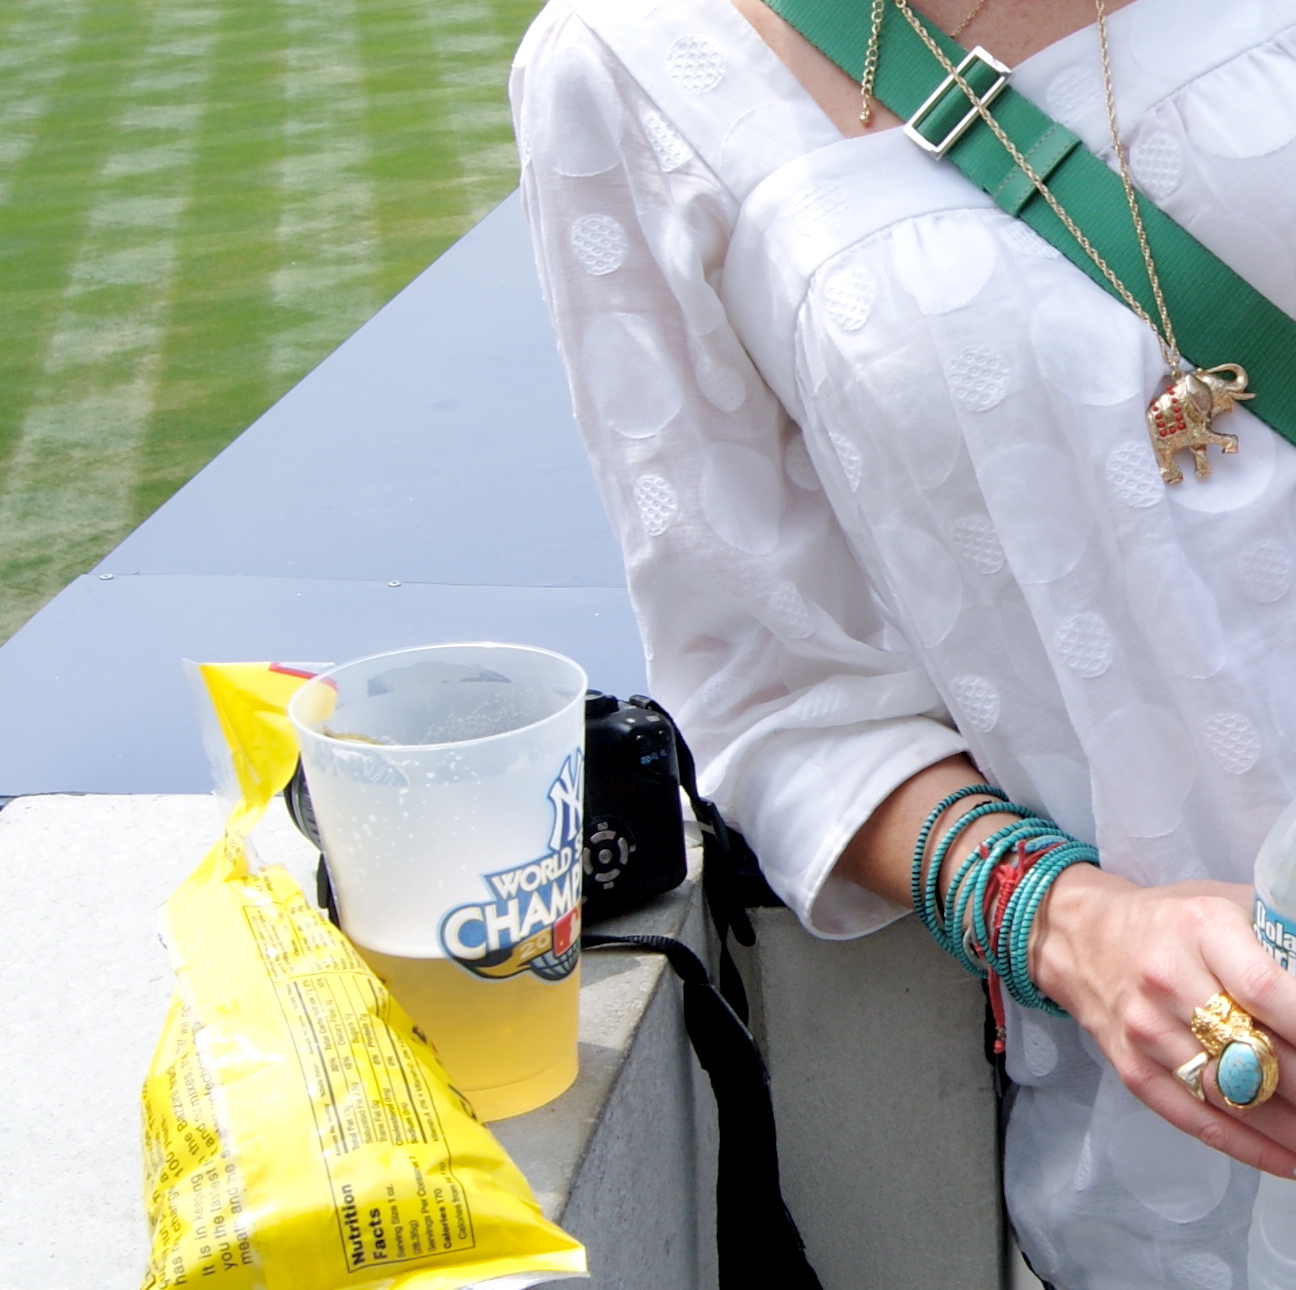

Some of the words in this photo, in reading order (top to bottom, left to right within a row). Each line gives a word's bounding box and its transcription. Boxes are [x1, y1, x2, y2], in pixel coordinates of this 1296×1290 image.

[491, 846, 573, 900] WORLD
[443, 860, 583, 961] CHAMP
[346, 1119, 354, 1132] Fat
[358, 1110, 373, 1144] Saturated
[377, 1123, 388, 1142] Trans
[385, 1104, 404, 1146] Cholesterol
[348, 1132, 360, 1152] Total
[419, 1198, 430, 1215] Per
[433, 1188, 445, 1205] 170
[449, 1184, 460, 1204] from
[213, 1215, 228, 1240] the
[341, 1184, 366, 1266] Nutrition
[390, 1205, 400, 1225] Size
[438, 1206, 452, 1249] Calories
[453, 1203, 467, 1240] Calories
[194, 1226, 207, 1240] in
[369, 1208, 388, 1260] Facts
[394, 1225, 406, 1258] Serving
[423, 1215, 436, 1252] Servings
[198, 1245, 212, 1259] is
[218, 1242, 239, 1272] you
[201, 1264, 216, 1277] It
